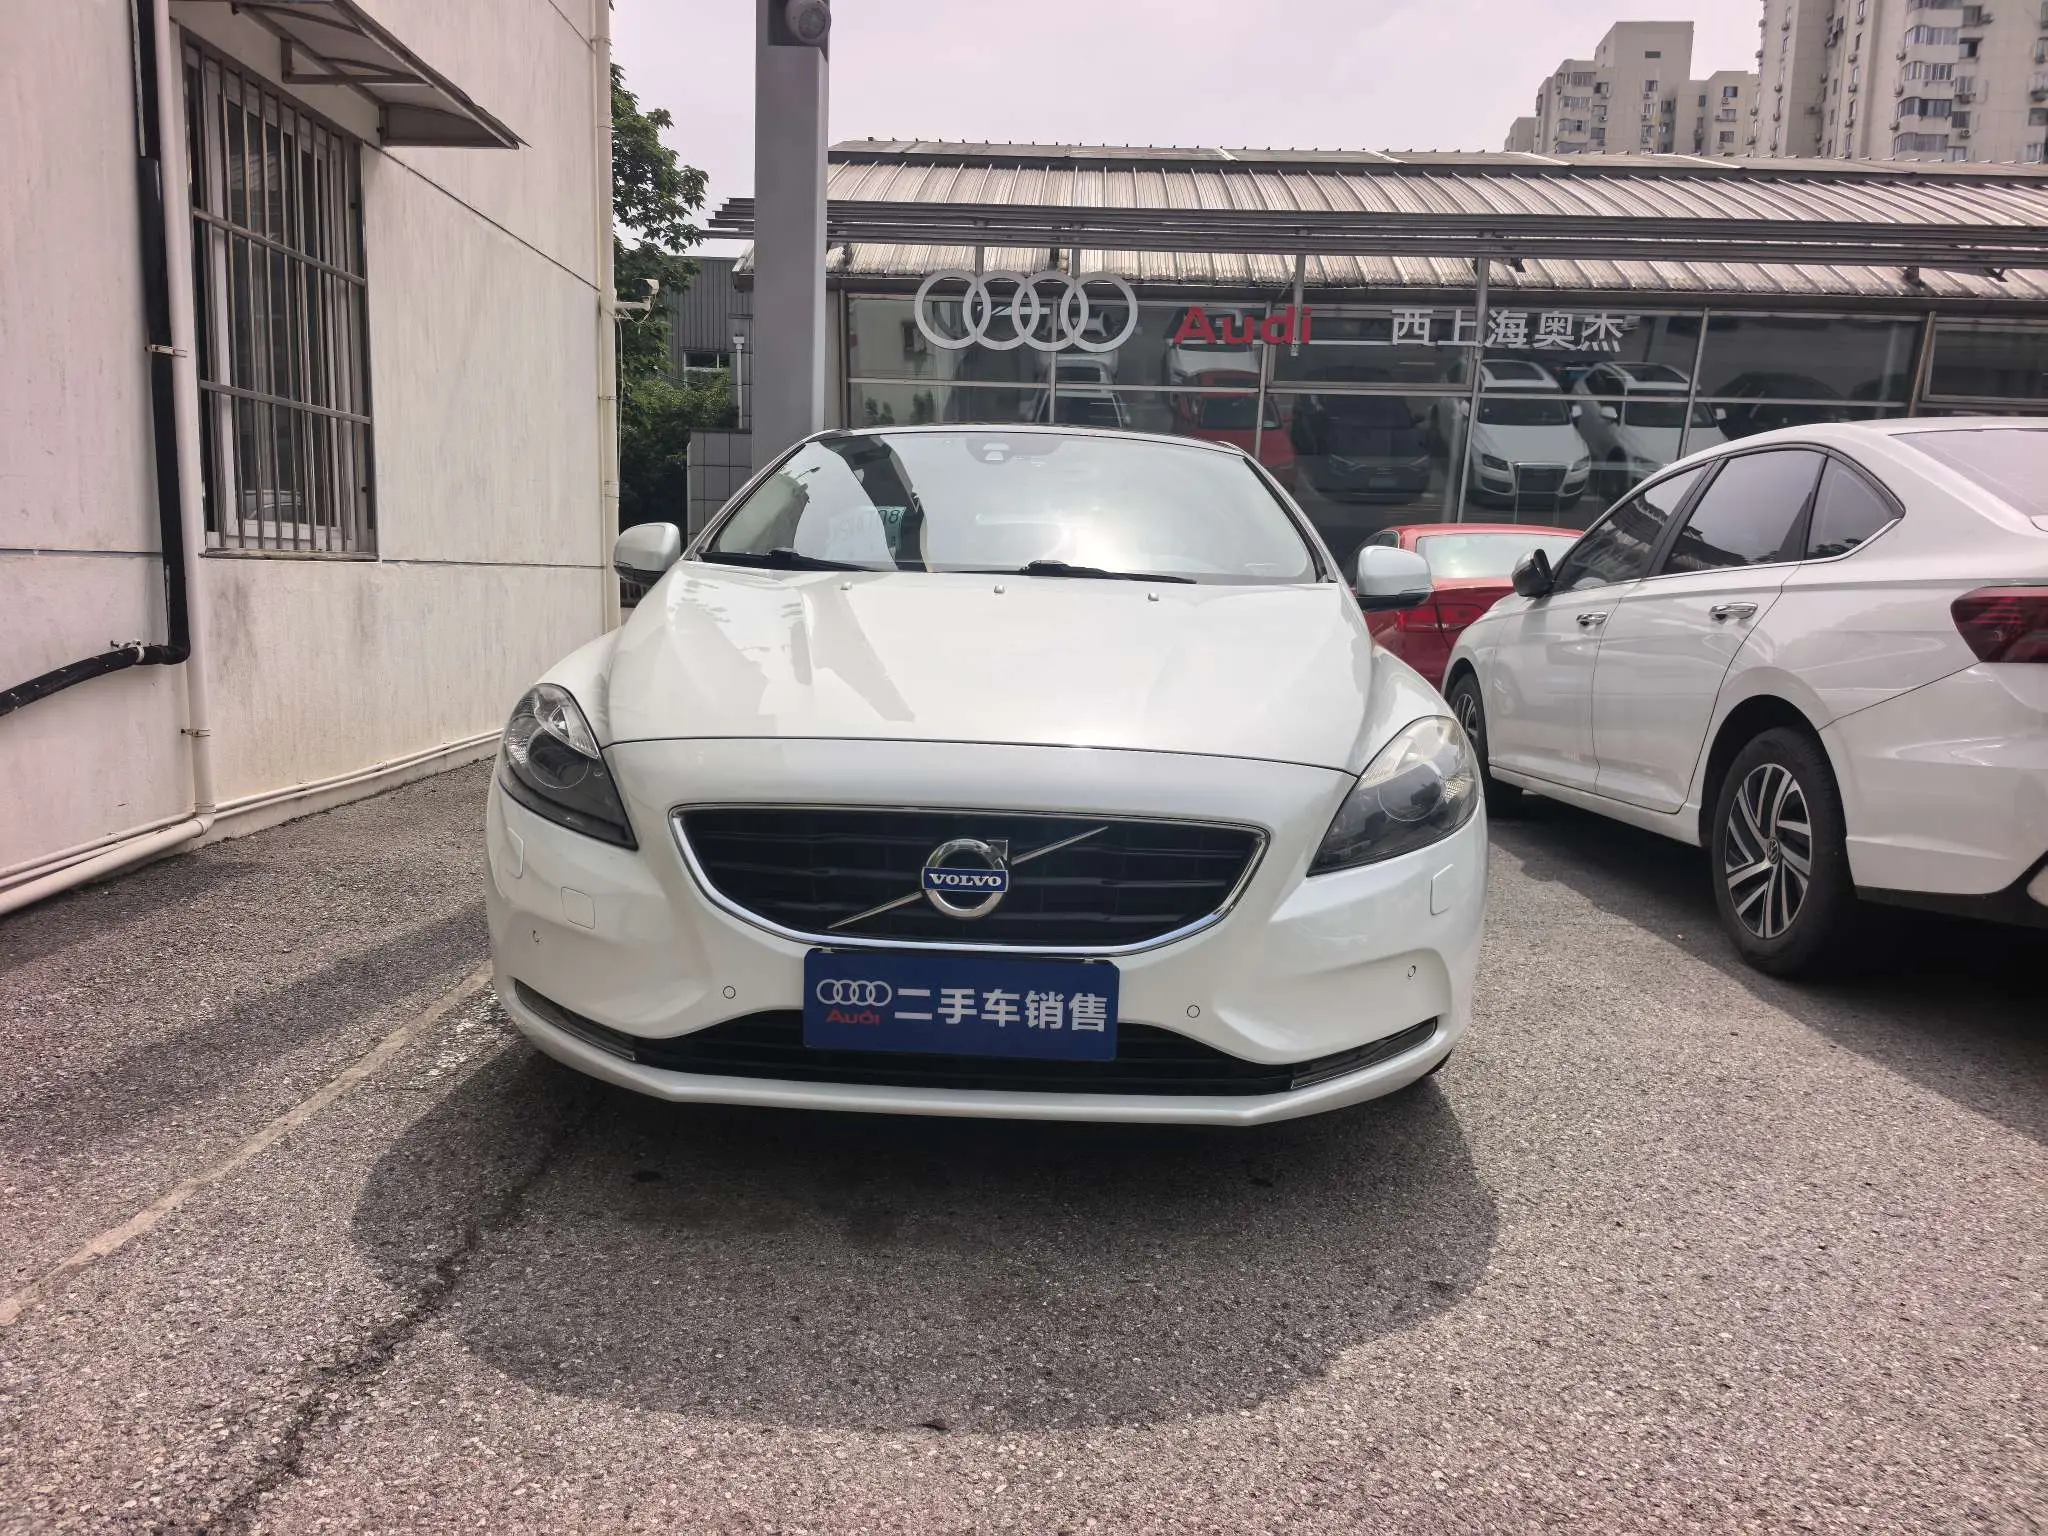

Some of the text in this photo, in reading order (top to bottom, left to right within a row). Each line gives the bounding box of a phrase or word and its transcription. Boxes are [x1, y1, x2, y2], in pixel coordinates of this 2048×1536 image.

[1173, 306, 1312, 346] Audi
[1391, 308, 1625, 352] 西上海奥杰
[928, 873, 1002, 888] VOLVO
[825, 1008, 881, 1026] Audi
[894, 987, 1109, 1033] 二手车销售
